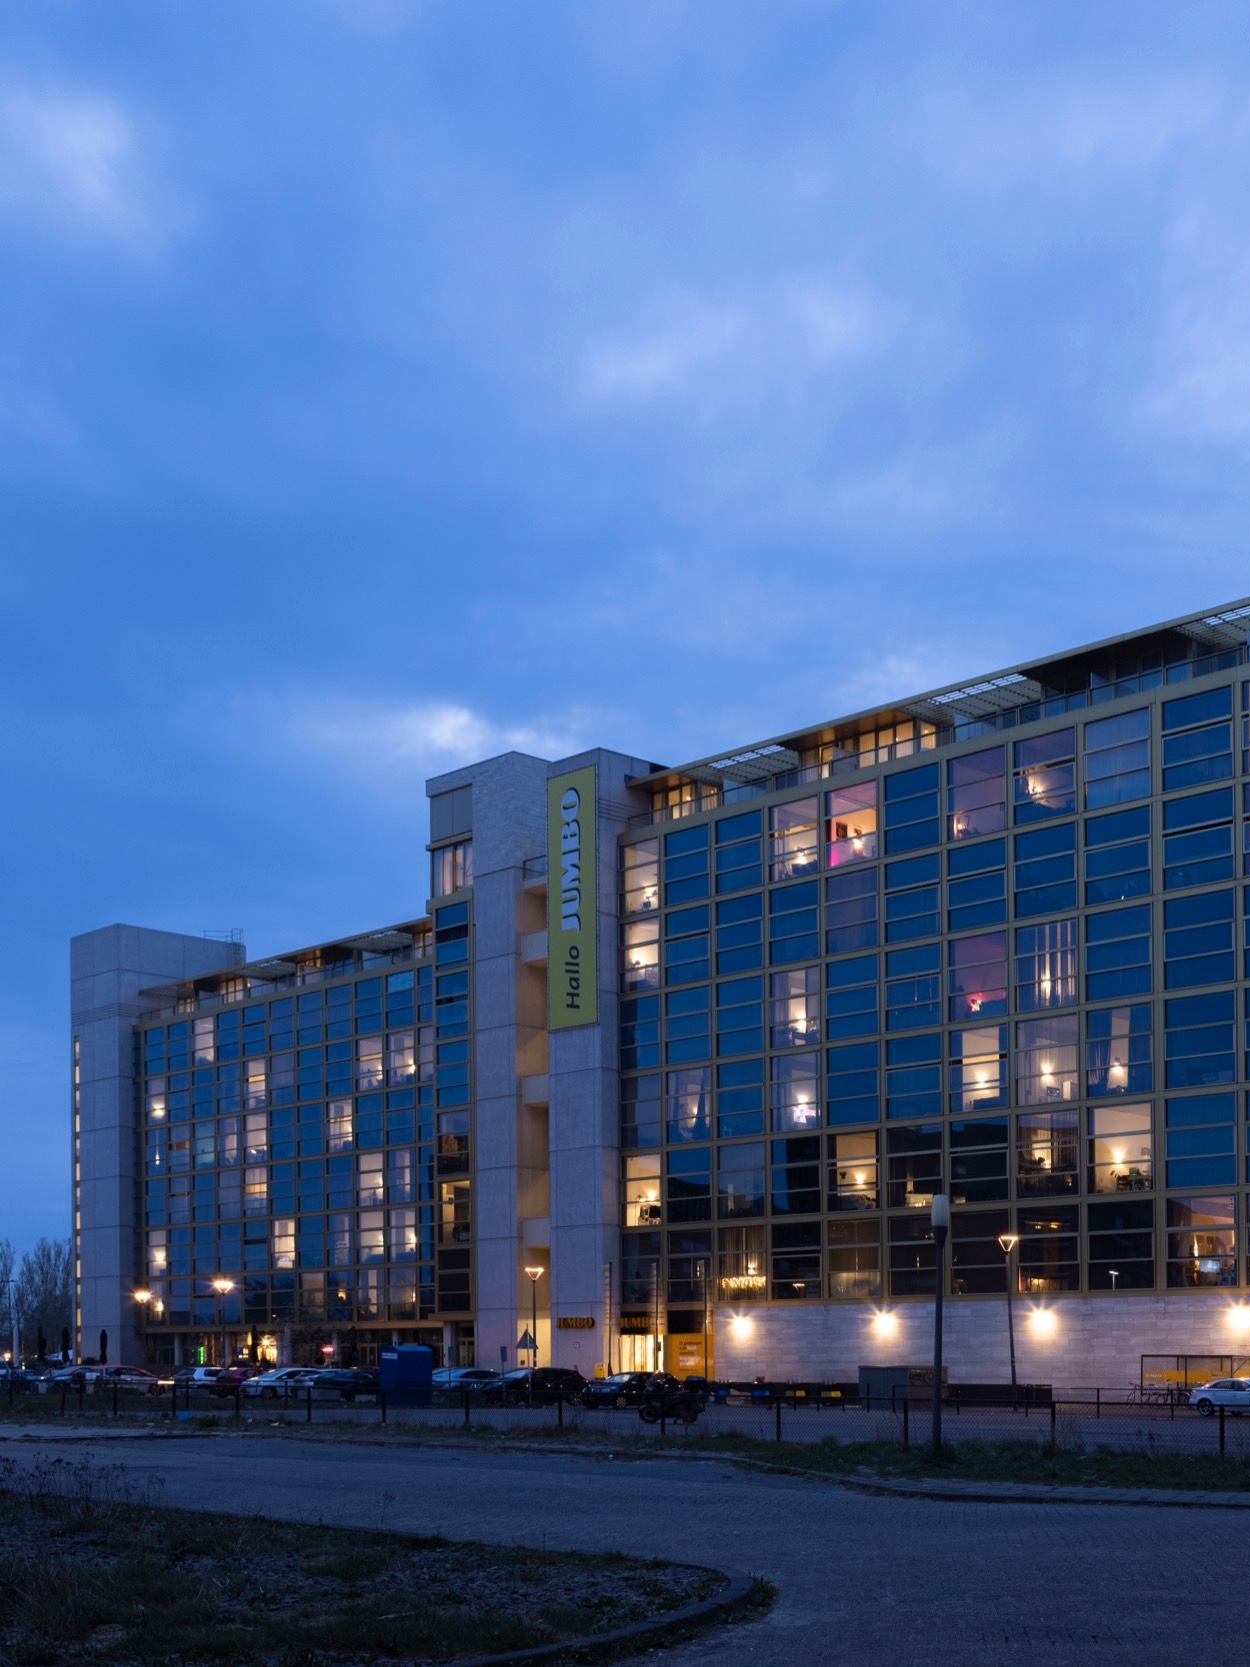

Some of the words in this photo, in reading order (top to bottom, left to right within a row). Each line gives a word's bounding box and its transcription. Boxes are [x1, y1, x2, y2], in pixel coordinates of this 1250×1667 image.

[560, 787, 581, 934] JUMBO
[566, 945, 580, 1010] Hallo
[557, 1317, 595, 1328] JUMBO
[620, 1317, 650, 1328] JUMB
